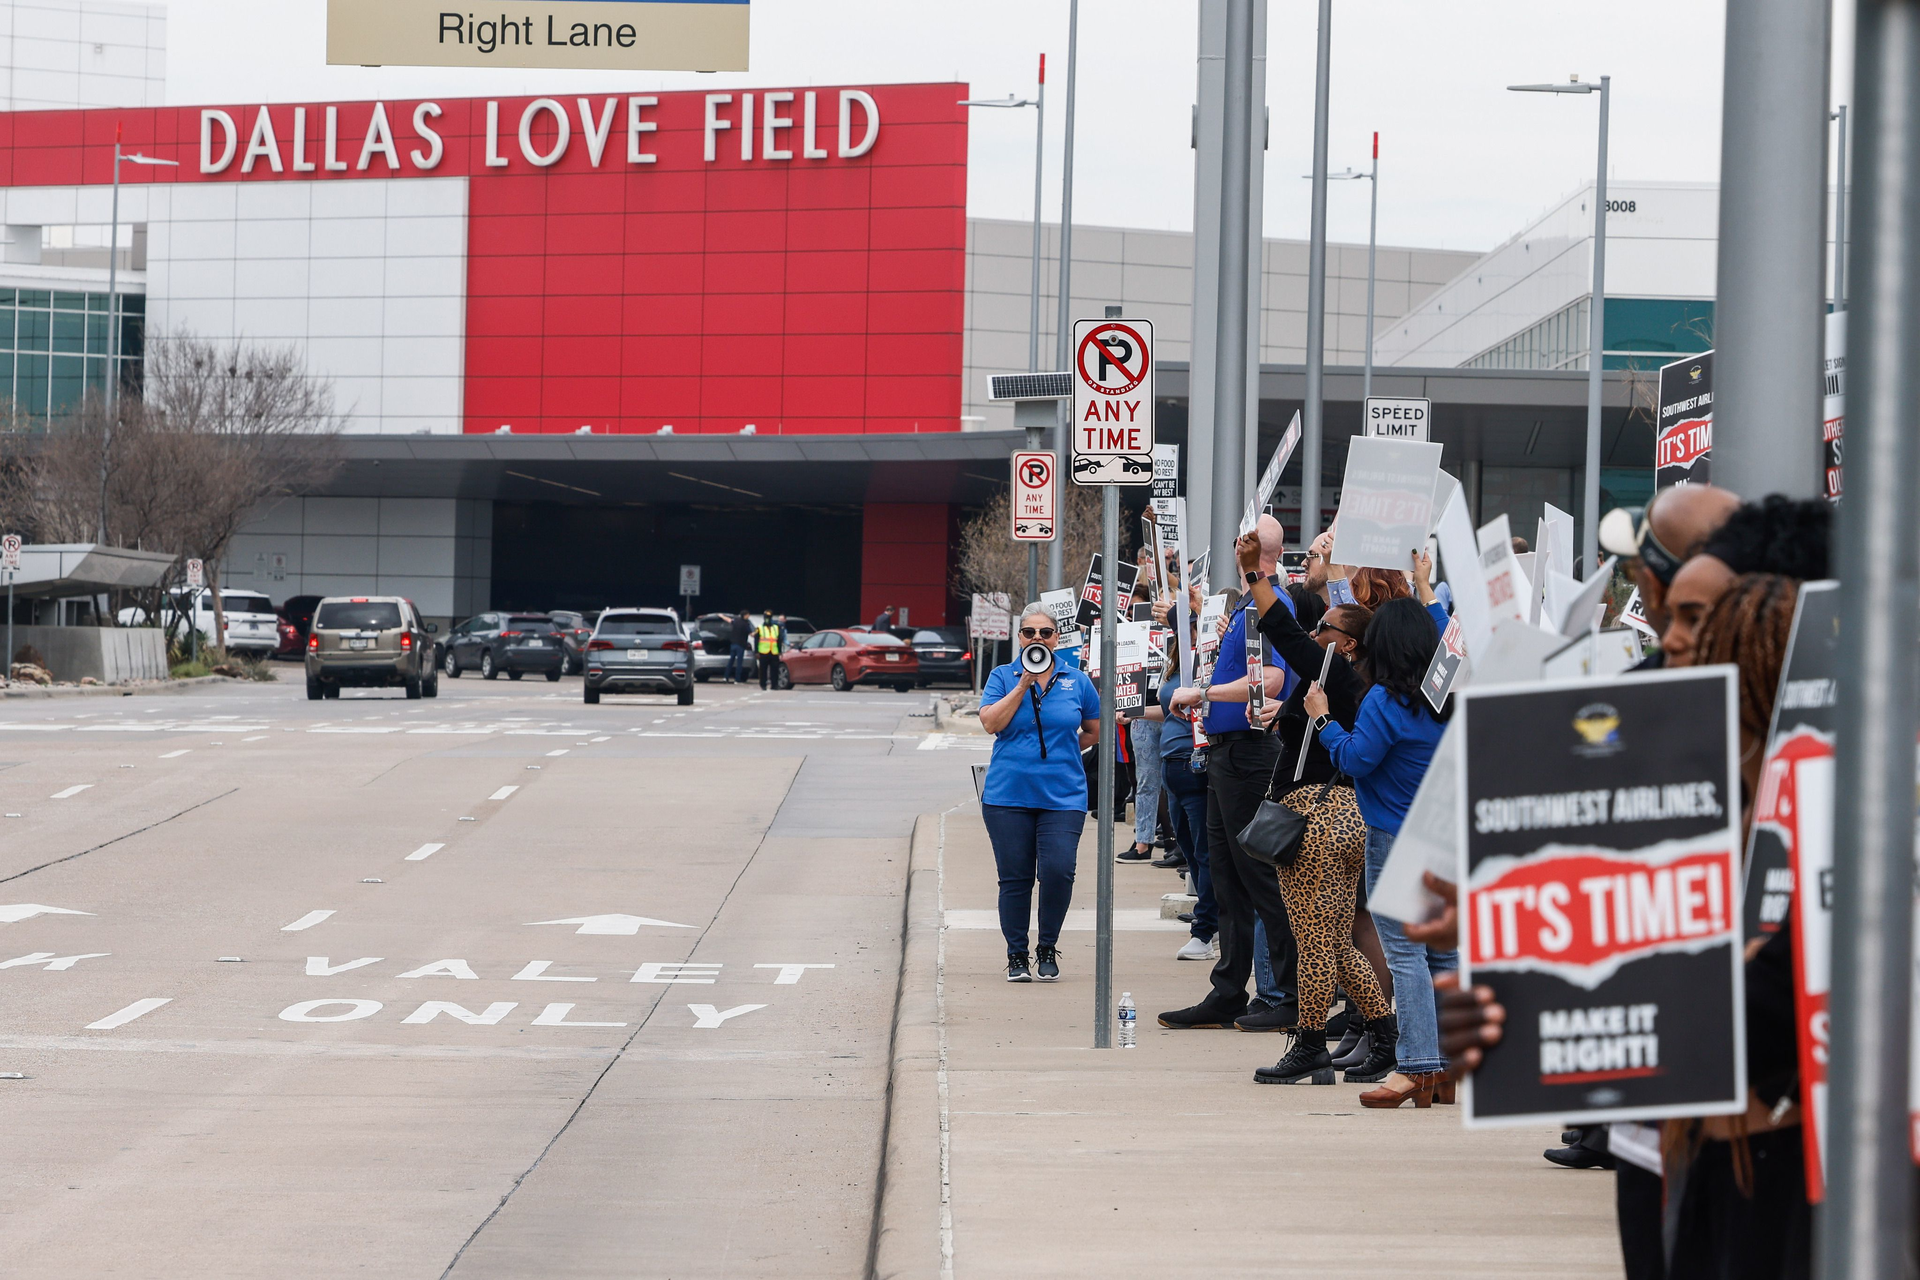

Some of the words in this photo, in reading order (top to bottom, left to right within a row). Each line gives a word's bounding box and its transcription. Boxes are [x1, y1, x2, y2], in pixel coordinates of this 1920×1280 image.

[438, 12, 533, 53] Right
[547, 14, 637, 47] Lane
[200, 101, 444, 174] DALLAS
[485, 96, 659, 167] LOVE
[704, 90, 880, 162] FIELD
[1100, 380, 1138, 394] STANDING
[1083, 400, 1142, 422] ANY
[1371, 407, 1424, 420] SPEED
[1662, 396, 1698, 418] SOUTHWEST
[1376, 423, 1418, 437] LIMIT
[1083, 428, 1142, 450] TIME
[1660, 432, 1686, 465] IT'S
[1161, 459, 1176, 468] FOOD
[1161, 467, 1174, 477] REST
[1155, 480, 1168, 489] CAN'T
[1168, 481, 1176, 489] BE
[1025, 493, 1043, 502] ANY
[1153, 488, 1161, 497] MY
[1161, 488, 1174, 497] BEST
[1024, 504, 1045, 514] TIME
[1084, 587, 1102, 602] IT'S
[1055, 600, 1074, 609] FOOD
[1058, 608, 1073, 617] REST
[1134, 663, 1141, 671] OF
[1474, 789, 1611, 834] SOUTHWEST
[1611, 780, 1723, 823] AIRLINES,
[1475, 880, 1573, 961] IT'S
[1578, 862, 1725, 948] TIME!
[305, 956, 836, 985] VALET
[278, 998, 769, 1029] ONLY
[1539, 1005, 1625, 1040] MAKE
[1627, 1002, 1659, 1034] IT
[1540, 1033, 1659, 1075] RIGHT!
